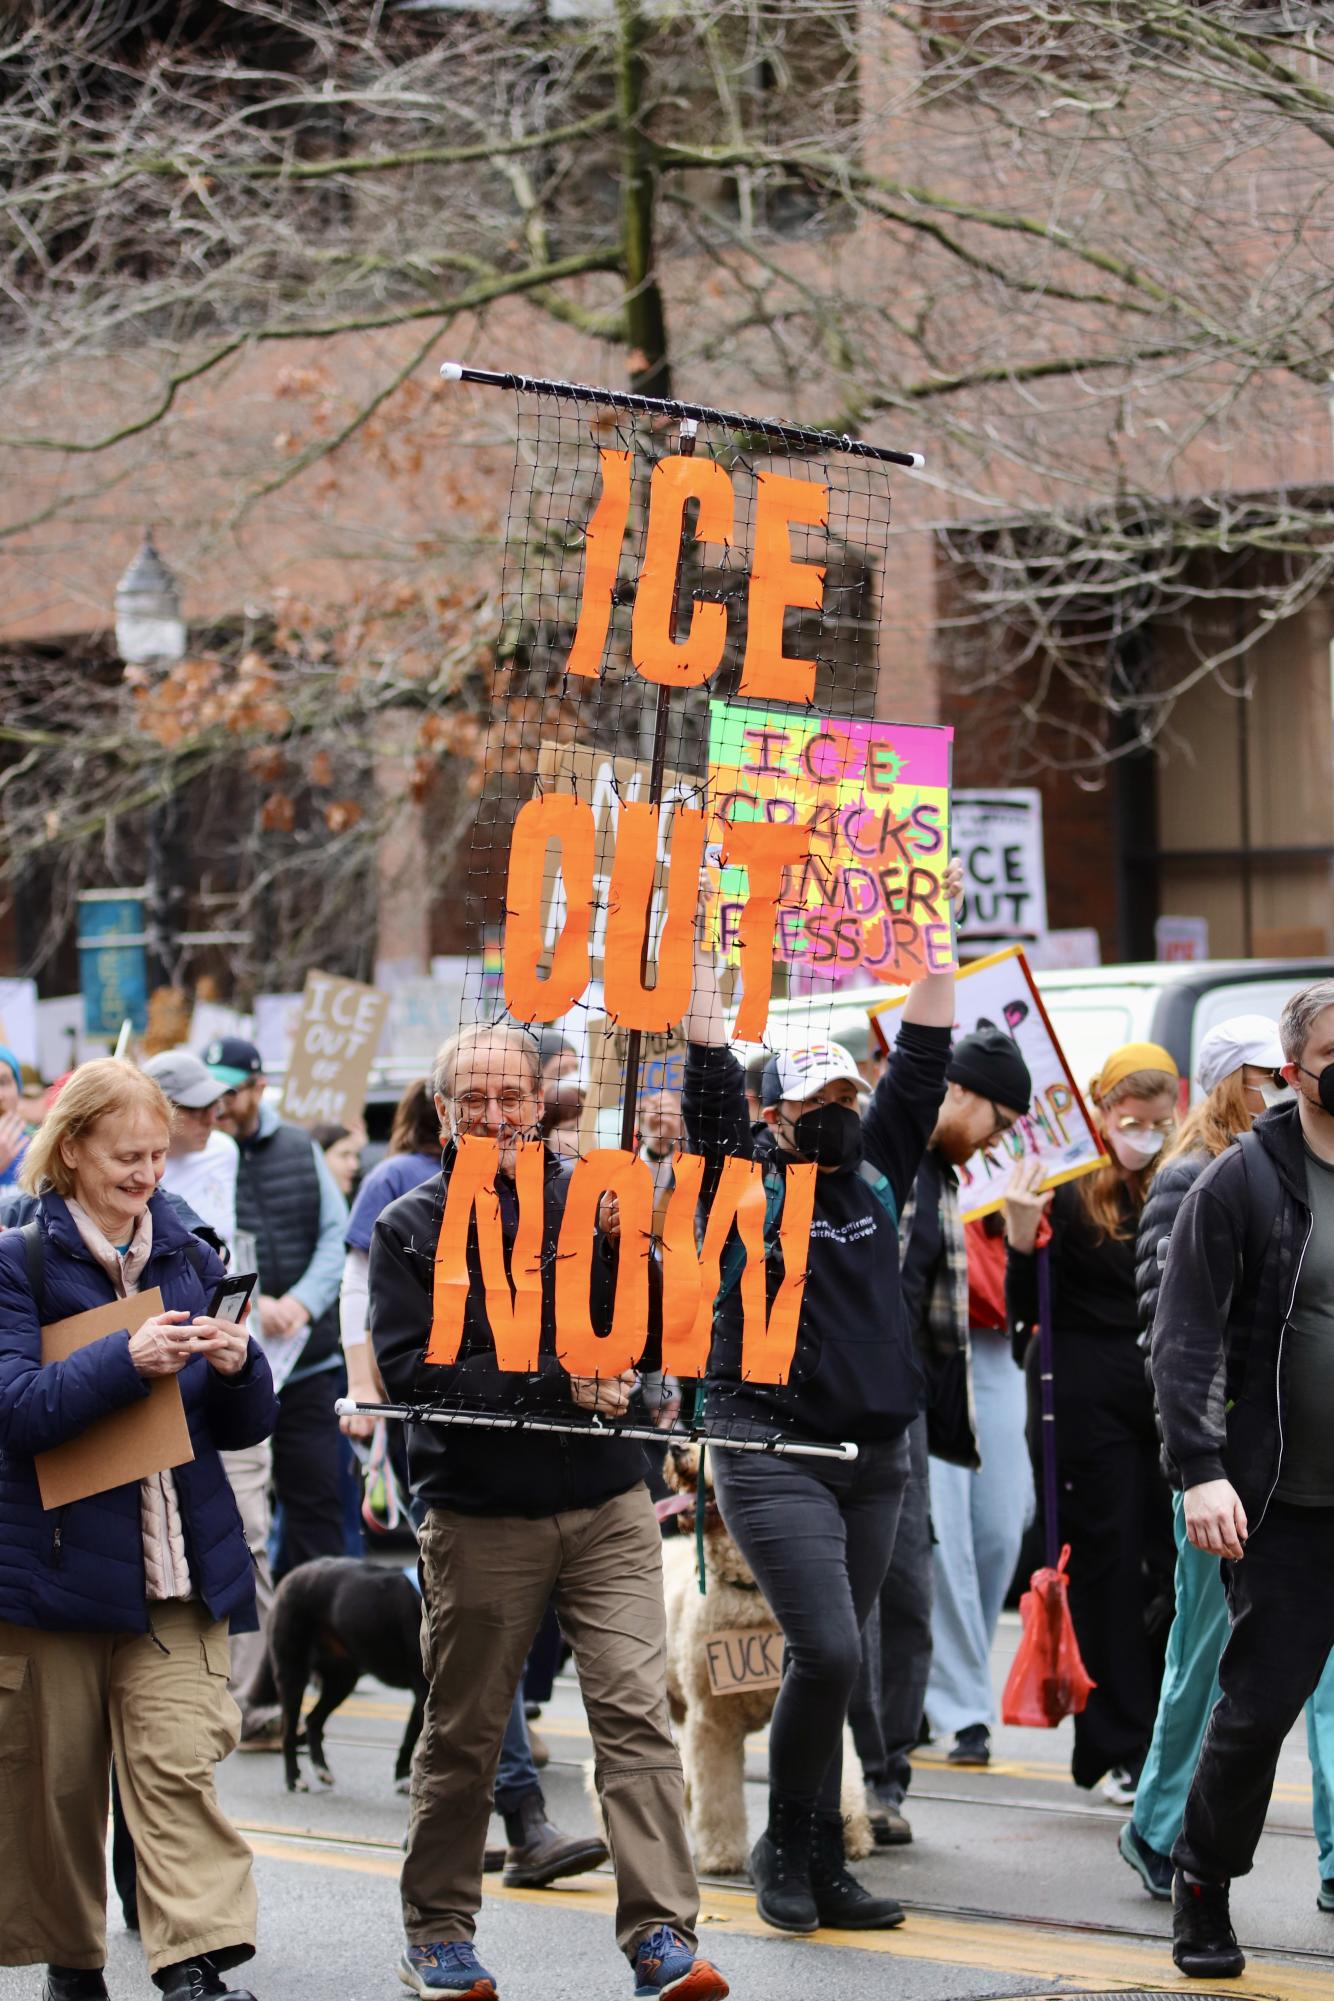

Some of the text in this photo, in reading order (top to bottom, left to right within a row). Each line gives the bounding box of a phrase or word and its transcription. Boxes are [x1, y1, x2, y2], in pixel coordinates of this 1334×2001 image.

[565, 448, 829, 701] ICE
[743, 731, 894, 794] ICE
[952, 845, 1025, 885] CE
[504, 792, 811, 1043] OUT
[304, 980, 383, 1033] ICE
[304, 1023, 368, 1060] OUT
[310, 1058, 343, 1083] OF
[284, 1076, 348, 1125] WA!
[425, 1134, 817, 1385] NOW
